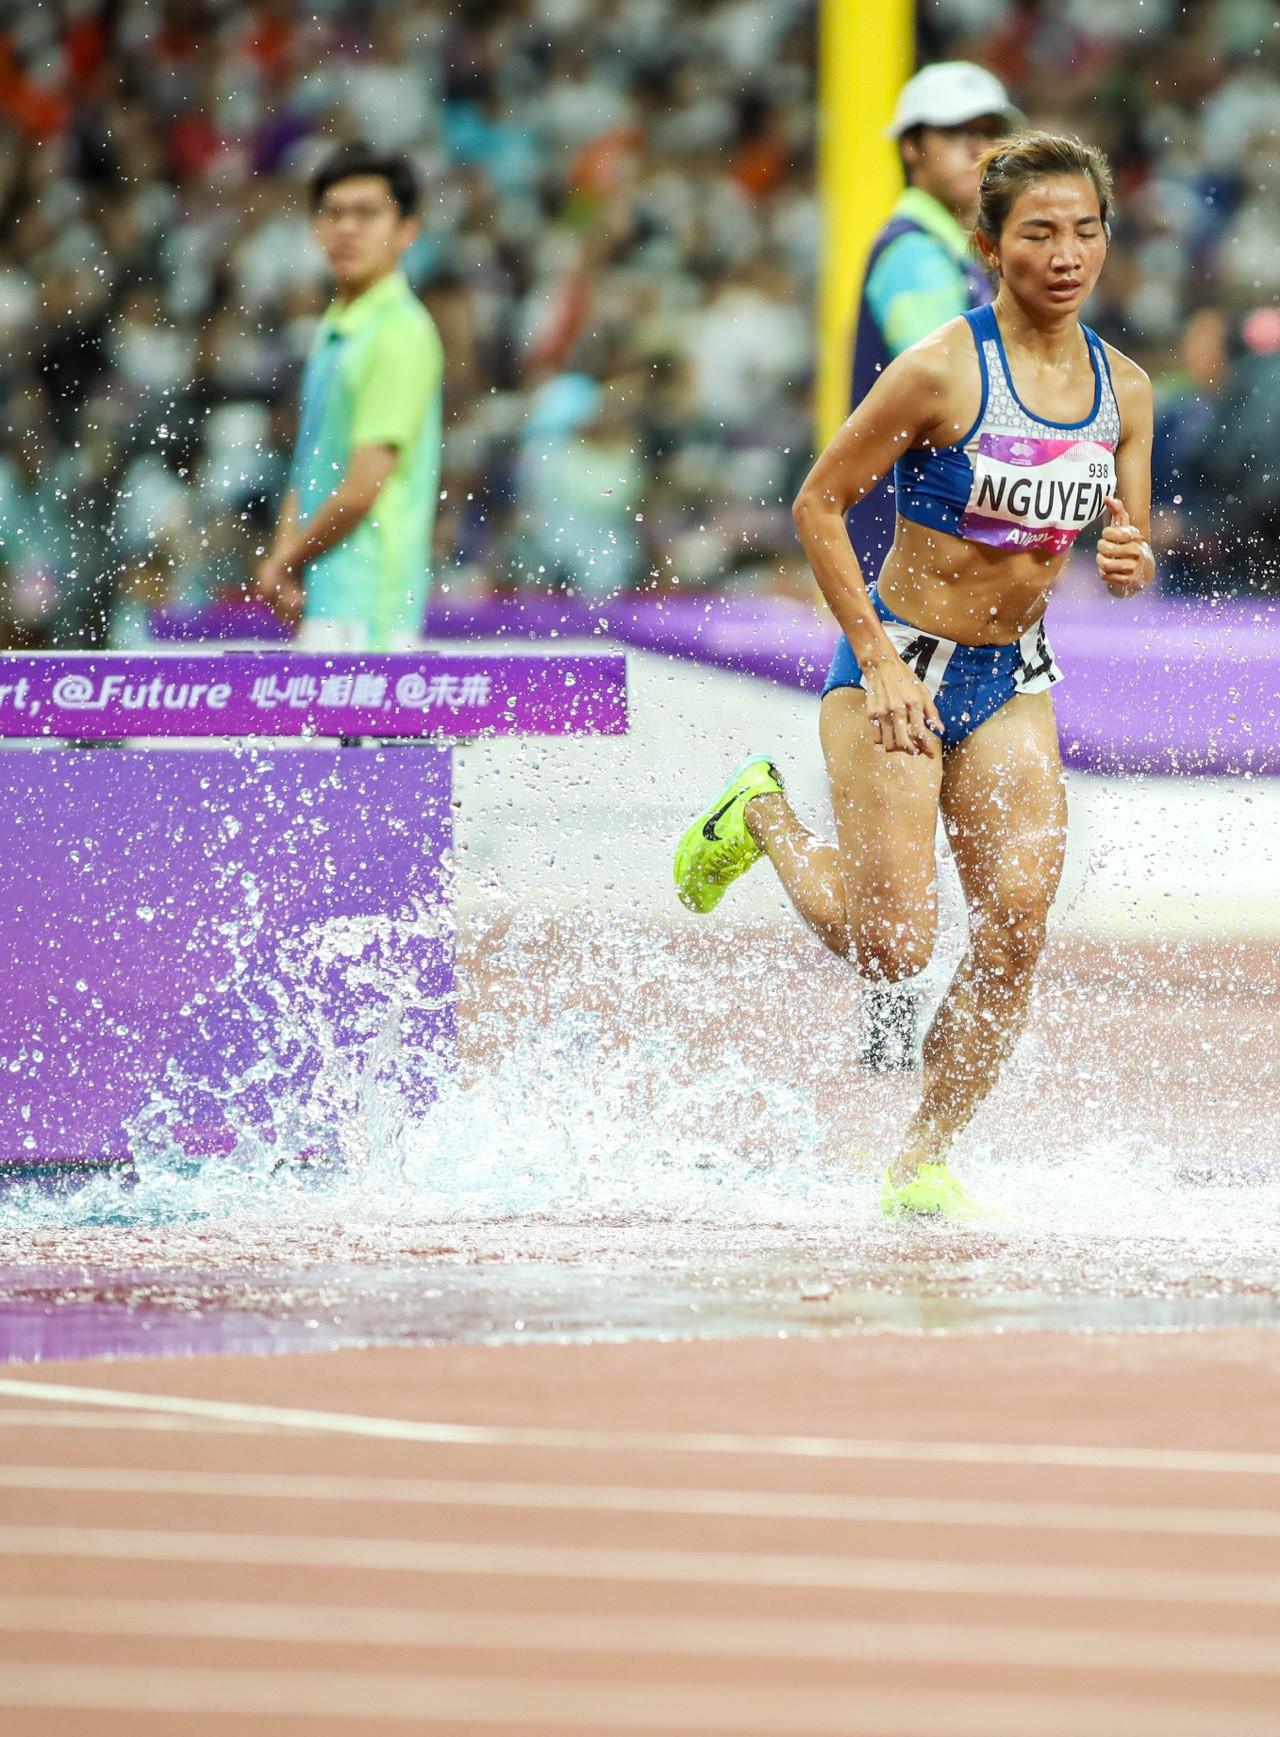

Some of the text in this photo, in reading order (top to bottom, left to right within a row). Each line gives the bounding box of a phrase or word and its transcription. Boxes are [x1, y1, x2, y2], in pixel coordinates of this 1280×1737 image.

[1088, 462, 1109, 479] 938
[976, 473, 1111, 522] NGUYEN
[52, 674, 233, 710] @Future
